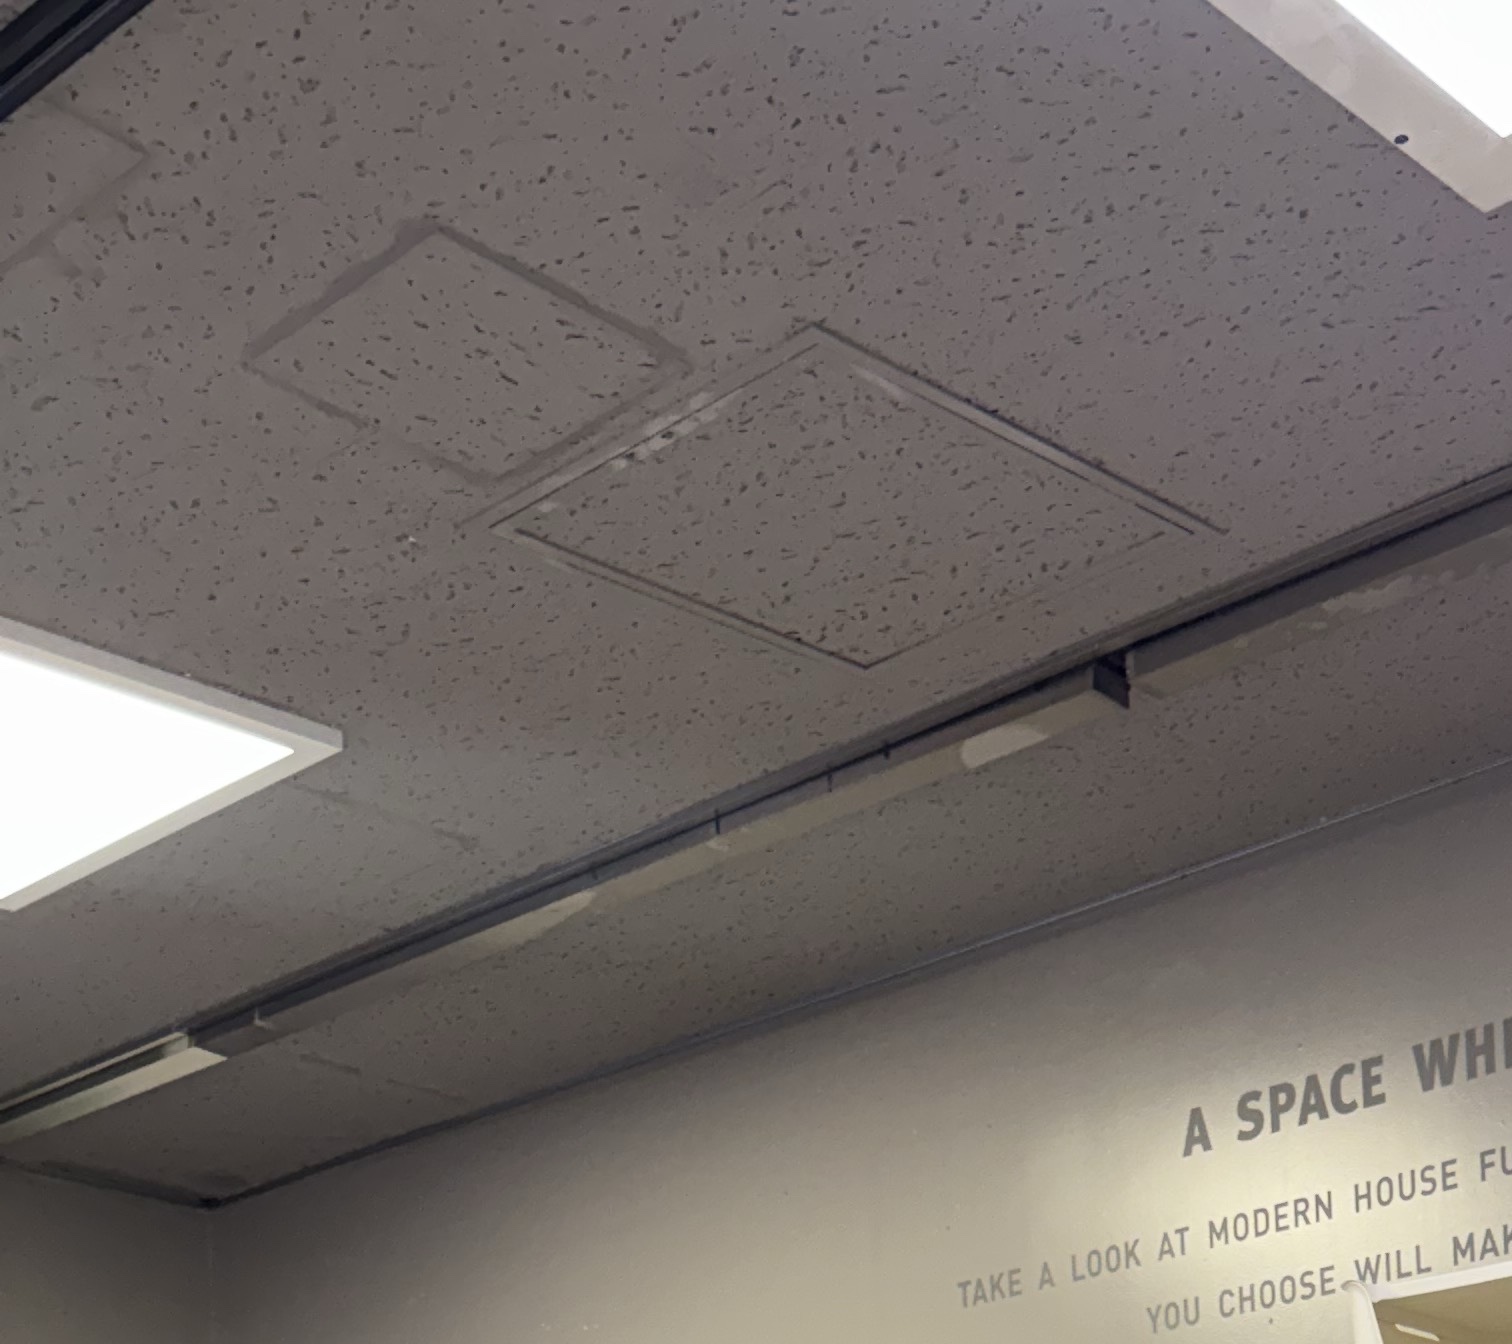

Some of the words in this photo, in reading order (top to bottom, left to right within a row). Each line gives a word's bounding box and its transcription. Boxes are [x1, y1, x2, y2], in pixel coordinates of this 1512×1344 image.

[1183, 1106, 1213, 1157] A
[1237, 1054, 1386, 1141] SPACE
[957, 1268, 1022, 1308] TAKE
[1039, 1262, 1056, 1290] A
[1071, 1238, 1142, 1282] LOOK
[1158, 1226, 1189, 1261] AT
[1208, 1190, 1333, 1249] MODERN
[1354, 1158, 1458, 1213] HOUSE
[1146, 1296, 1200, 1334] YOU
[1218, 1265, 1336, 1318] CHOOSE
[1354, 1245, 1432, 1284] WILL
